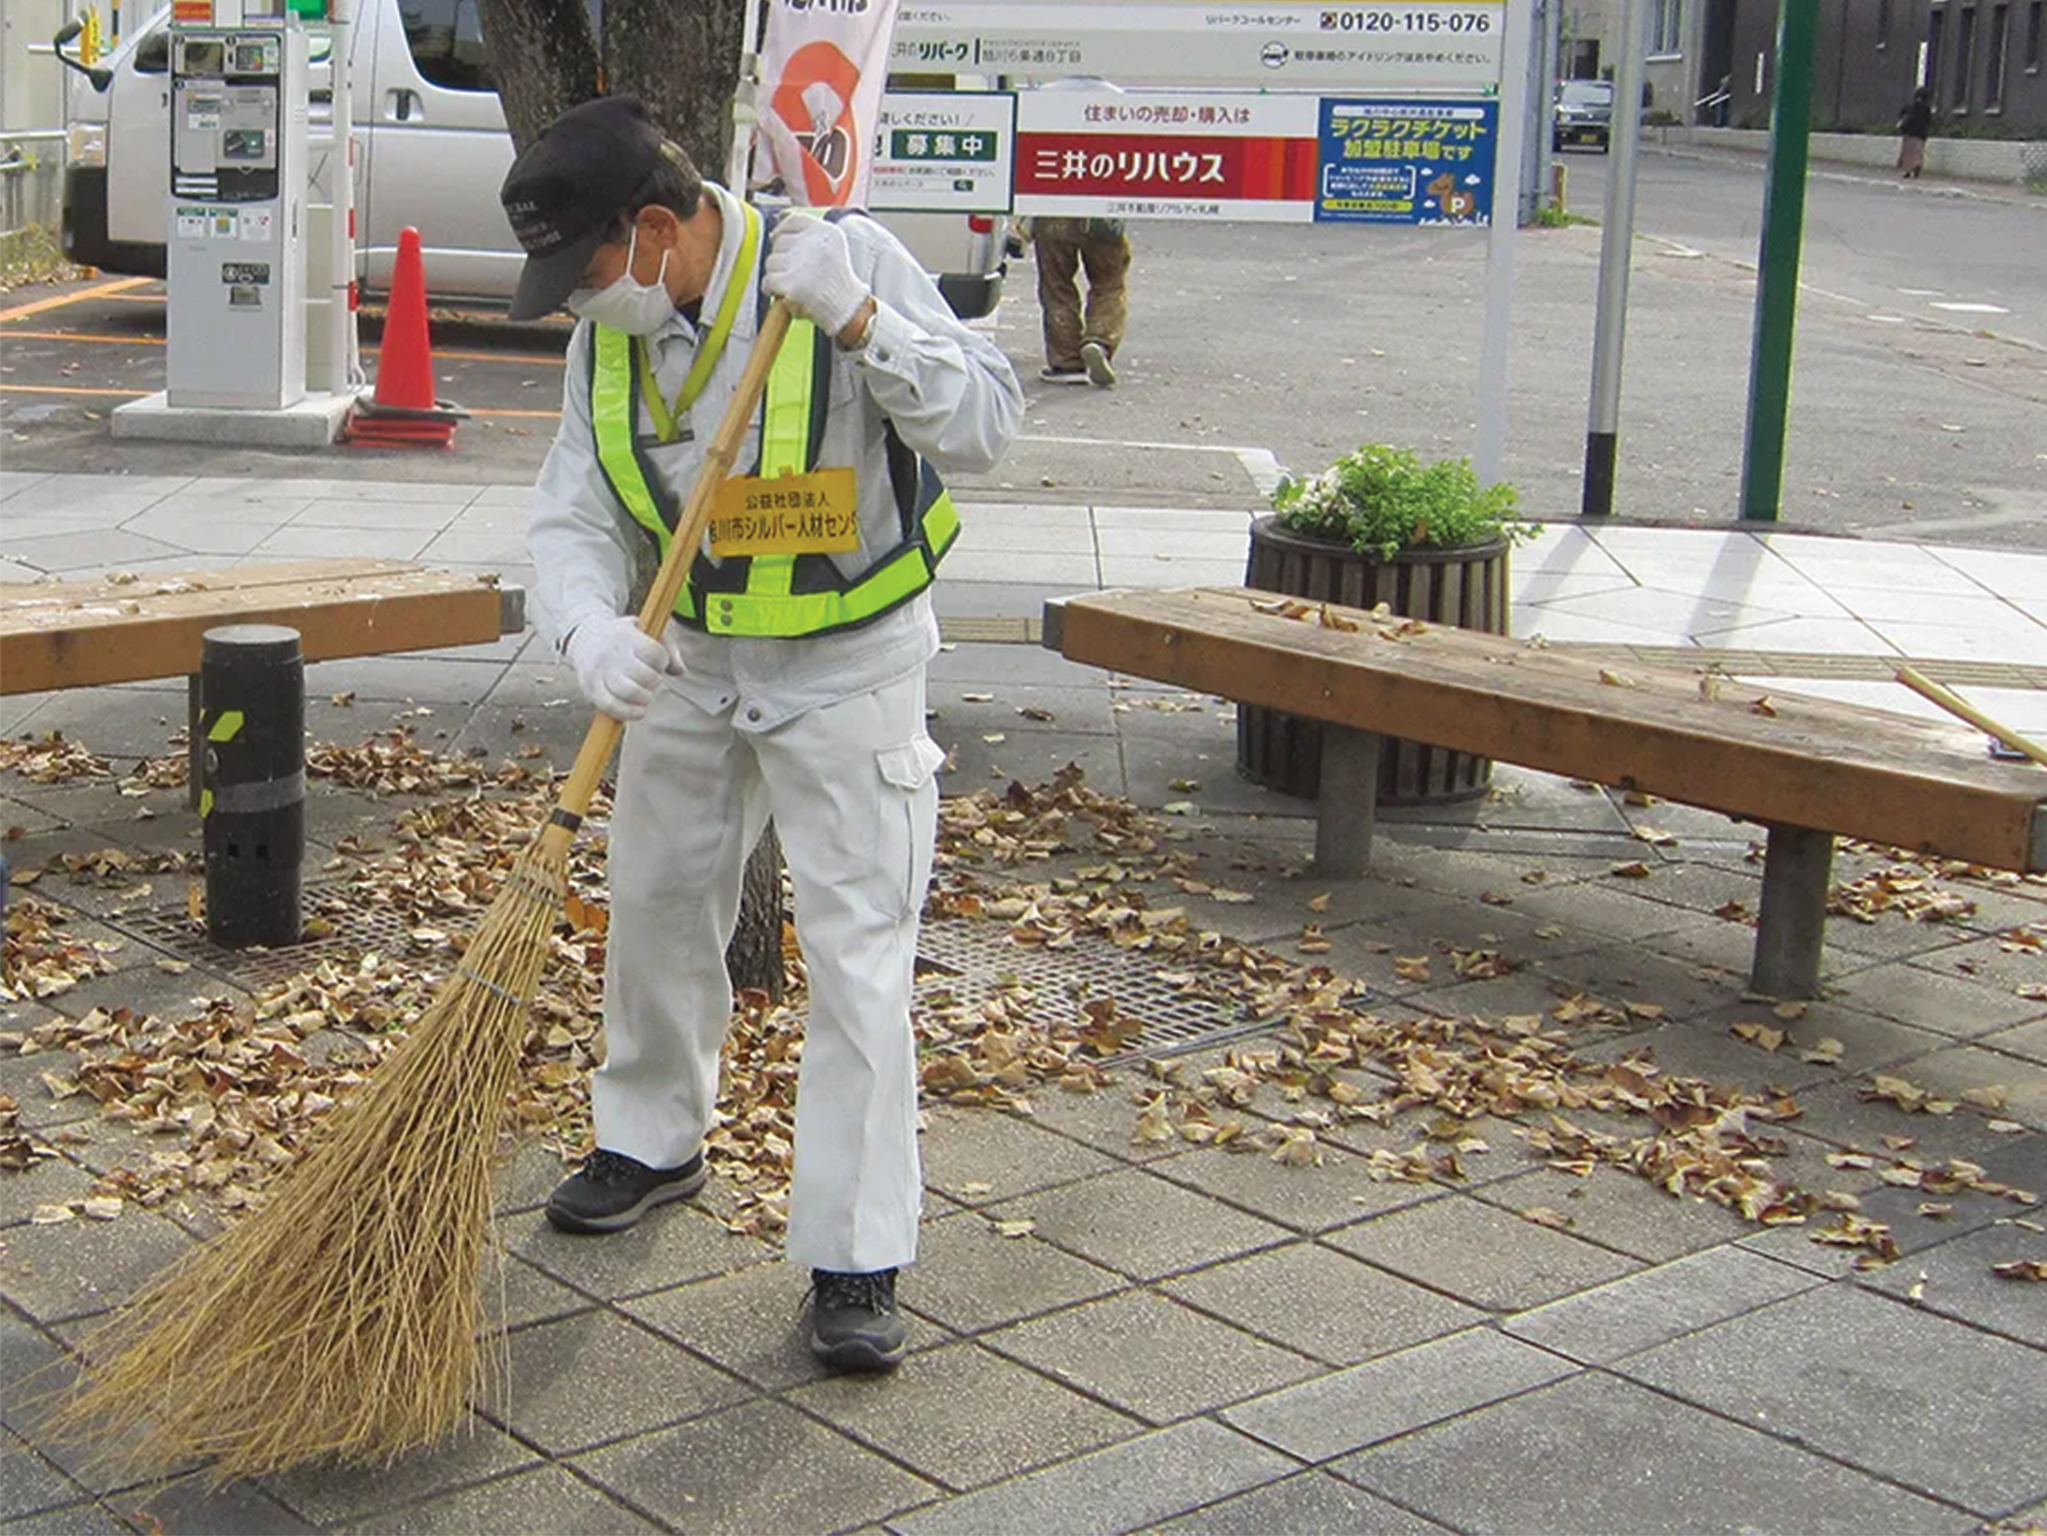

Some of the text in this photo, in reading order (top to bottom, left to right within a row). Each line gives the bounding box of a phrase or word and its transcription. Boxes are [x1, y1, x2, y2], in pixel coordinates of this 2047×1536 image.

[1084, 104, 1250, 124] 住まいの売却・購入は
[1330, 118, 1487, 140] ラクラクチケット
[906, 134, 982, 156] 募集中
[1343, 139, 1474, 161] 加盟駐車場です
[1034, 148, 1225, 183] 三井のリハウス
[746, 491, 830, 510] 公益社団法人
